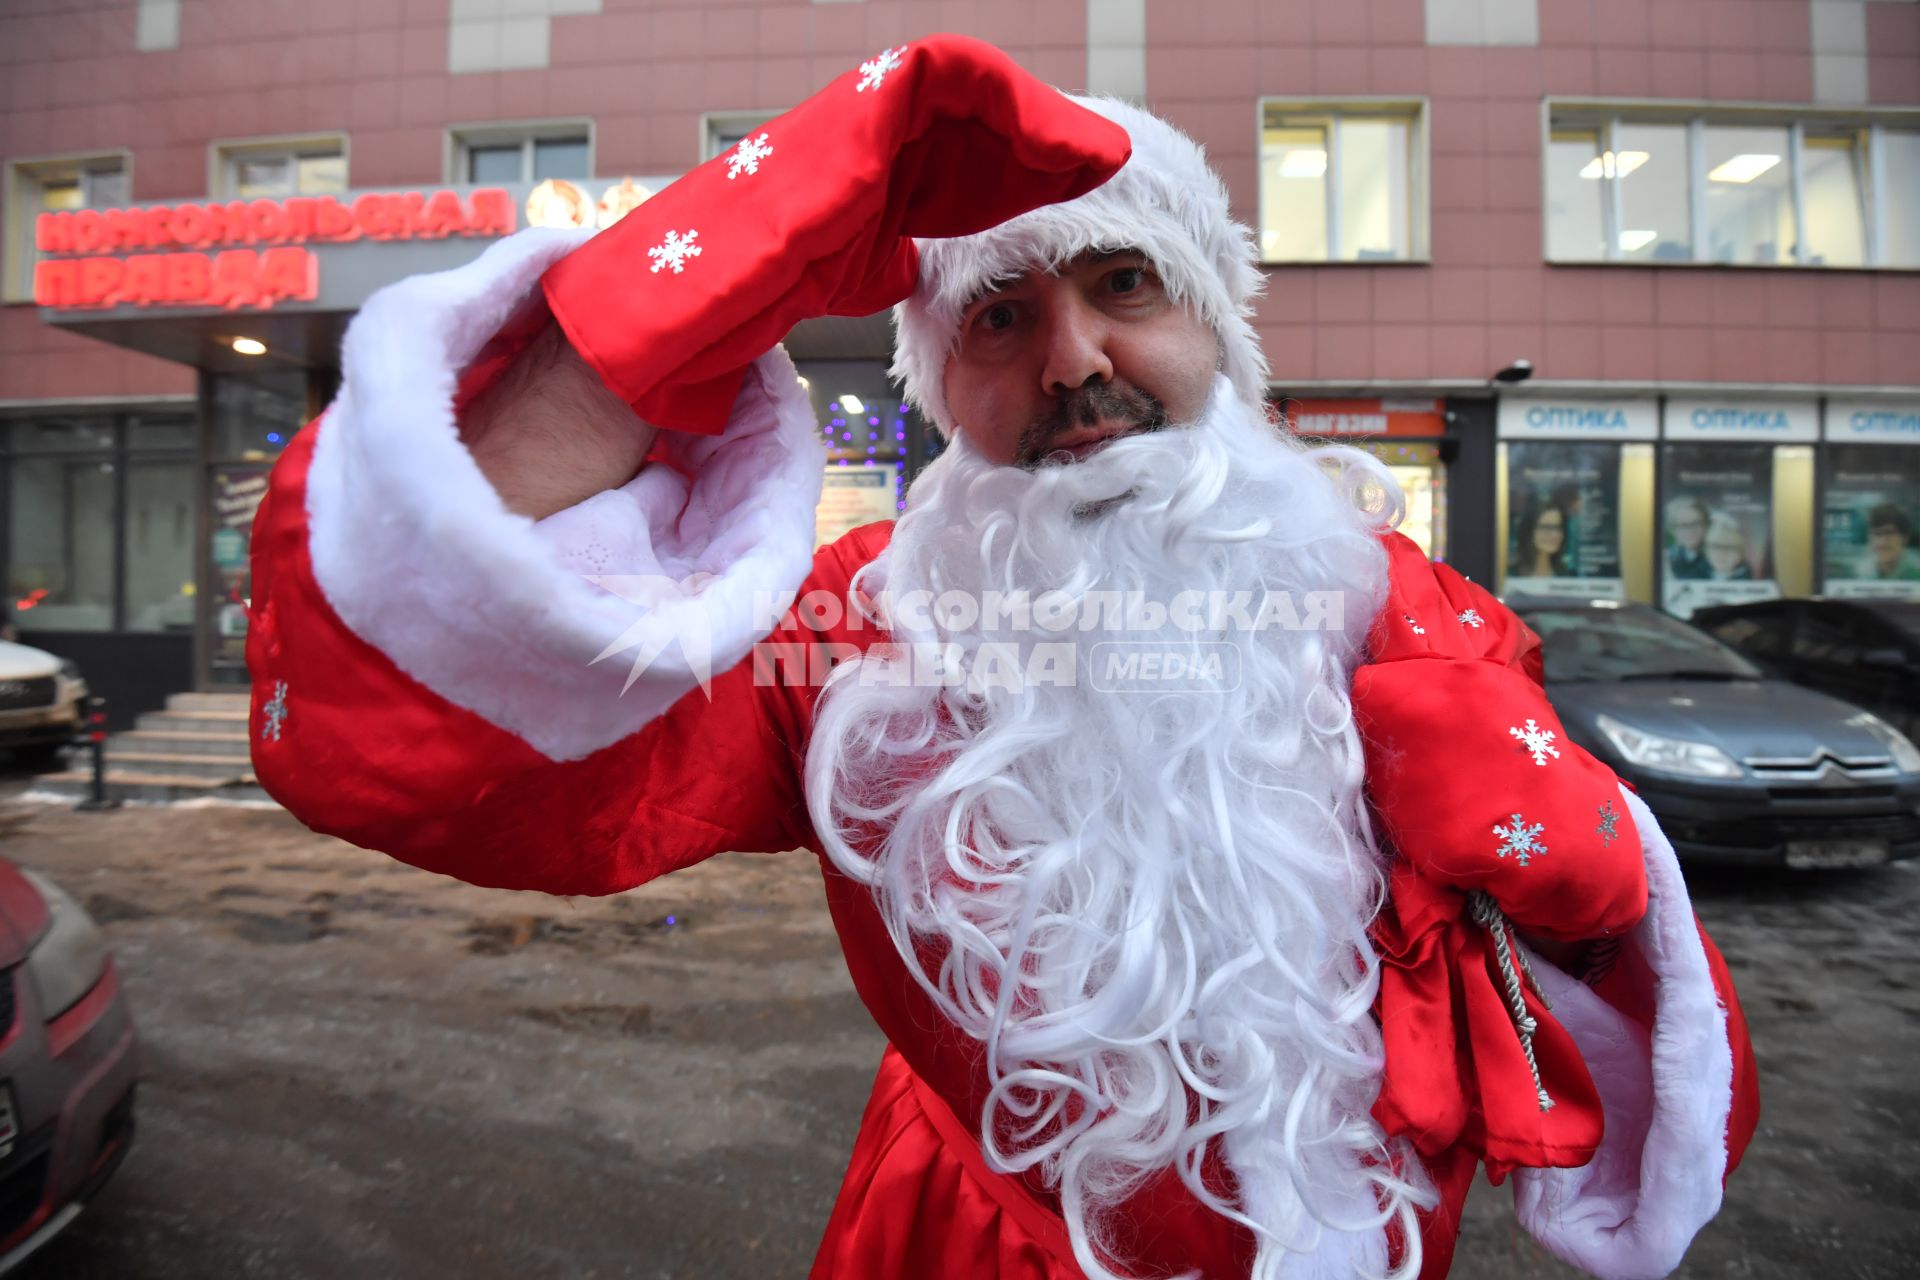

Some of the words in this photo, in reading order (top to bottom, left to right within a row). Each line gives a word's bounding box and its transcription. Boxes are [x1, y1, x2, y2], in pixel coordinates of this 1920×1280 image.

[35, 188, 516, 254] КОМСОМОЛЬСКАЯ
[34, 246, 318, 309] ПРАВДА
[1296, 414, 1388, 433] МАГАЗИН
[1526, 406, 1627, 428] ОПТИКА
[1691, 408, 1790, 430] ОПТИКА
[1850, 411, 1920, 433] ОПТИ
